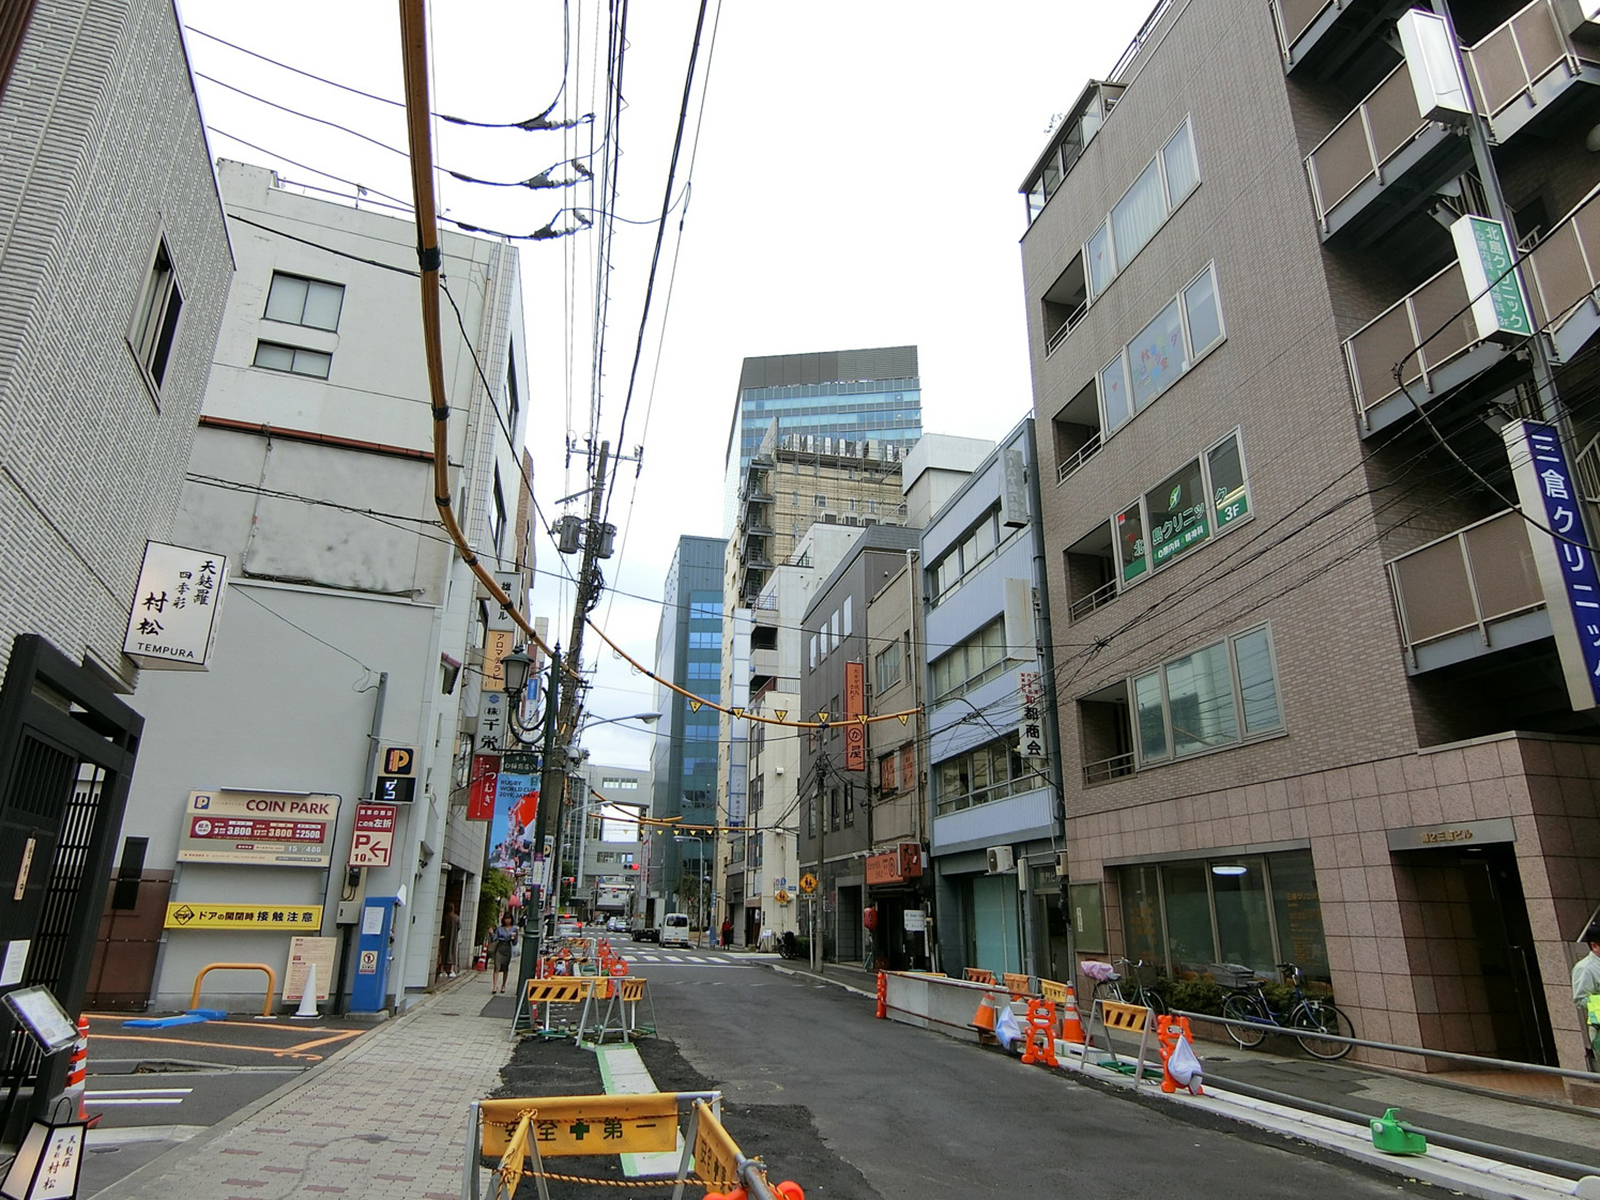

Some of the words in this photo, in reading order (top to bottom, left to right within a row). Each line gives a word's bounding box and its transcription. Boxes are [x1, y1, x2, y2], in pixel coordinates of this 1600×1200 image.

[1223, 503, 1240, 521] 3F
[136, 591, 169, 636] 村松
[137, 642, 195, 658] TEMPURA
[483, 771, 497, 806] つむぎ
[246, 799, 286, 812] COIN
[289, 802, 330, 814] PARK
[354, 834, 371, 849] P
